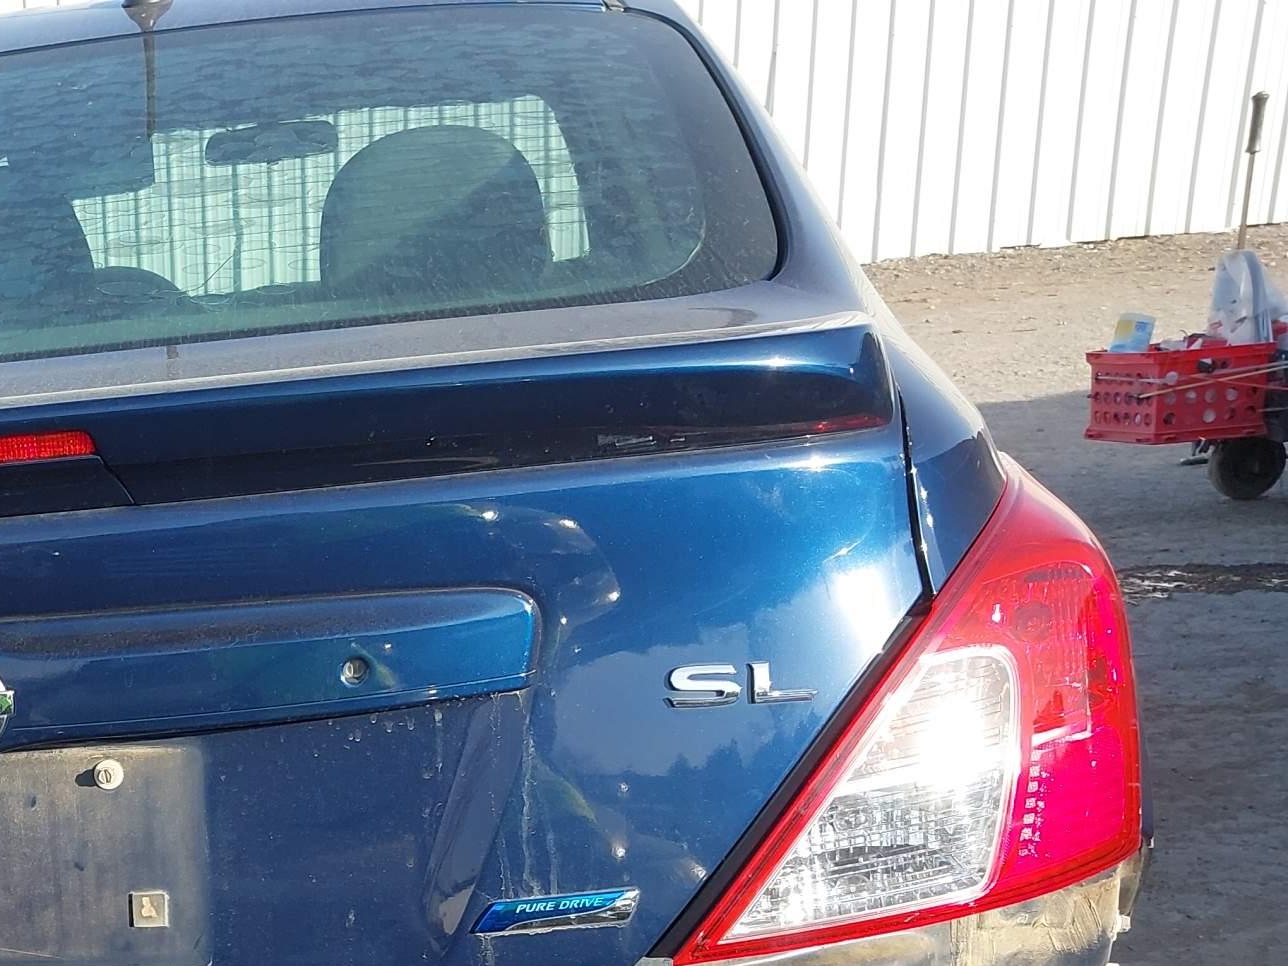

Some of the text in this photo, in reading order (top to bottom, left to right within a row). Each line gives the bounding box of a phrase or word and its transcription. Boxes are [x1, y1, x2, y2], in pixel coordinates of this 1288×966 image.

[663, 661, 818, 709] SL
[515, 897, 605, 914] PURE DRIVE
